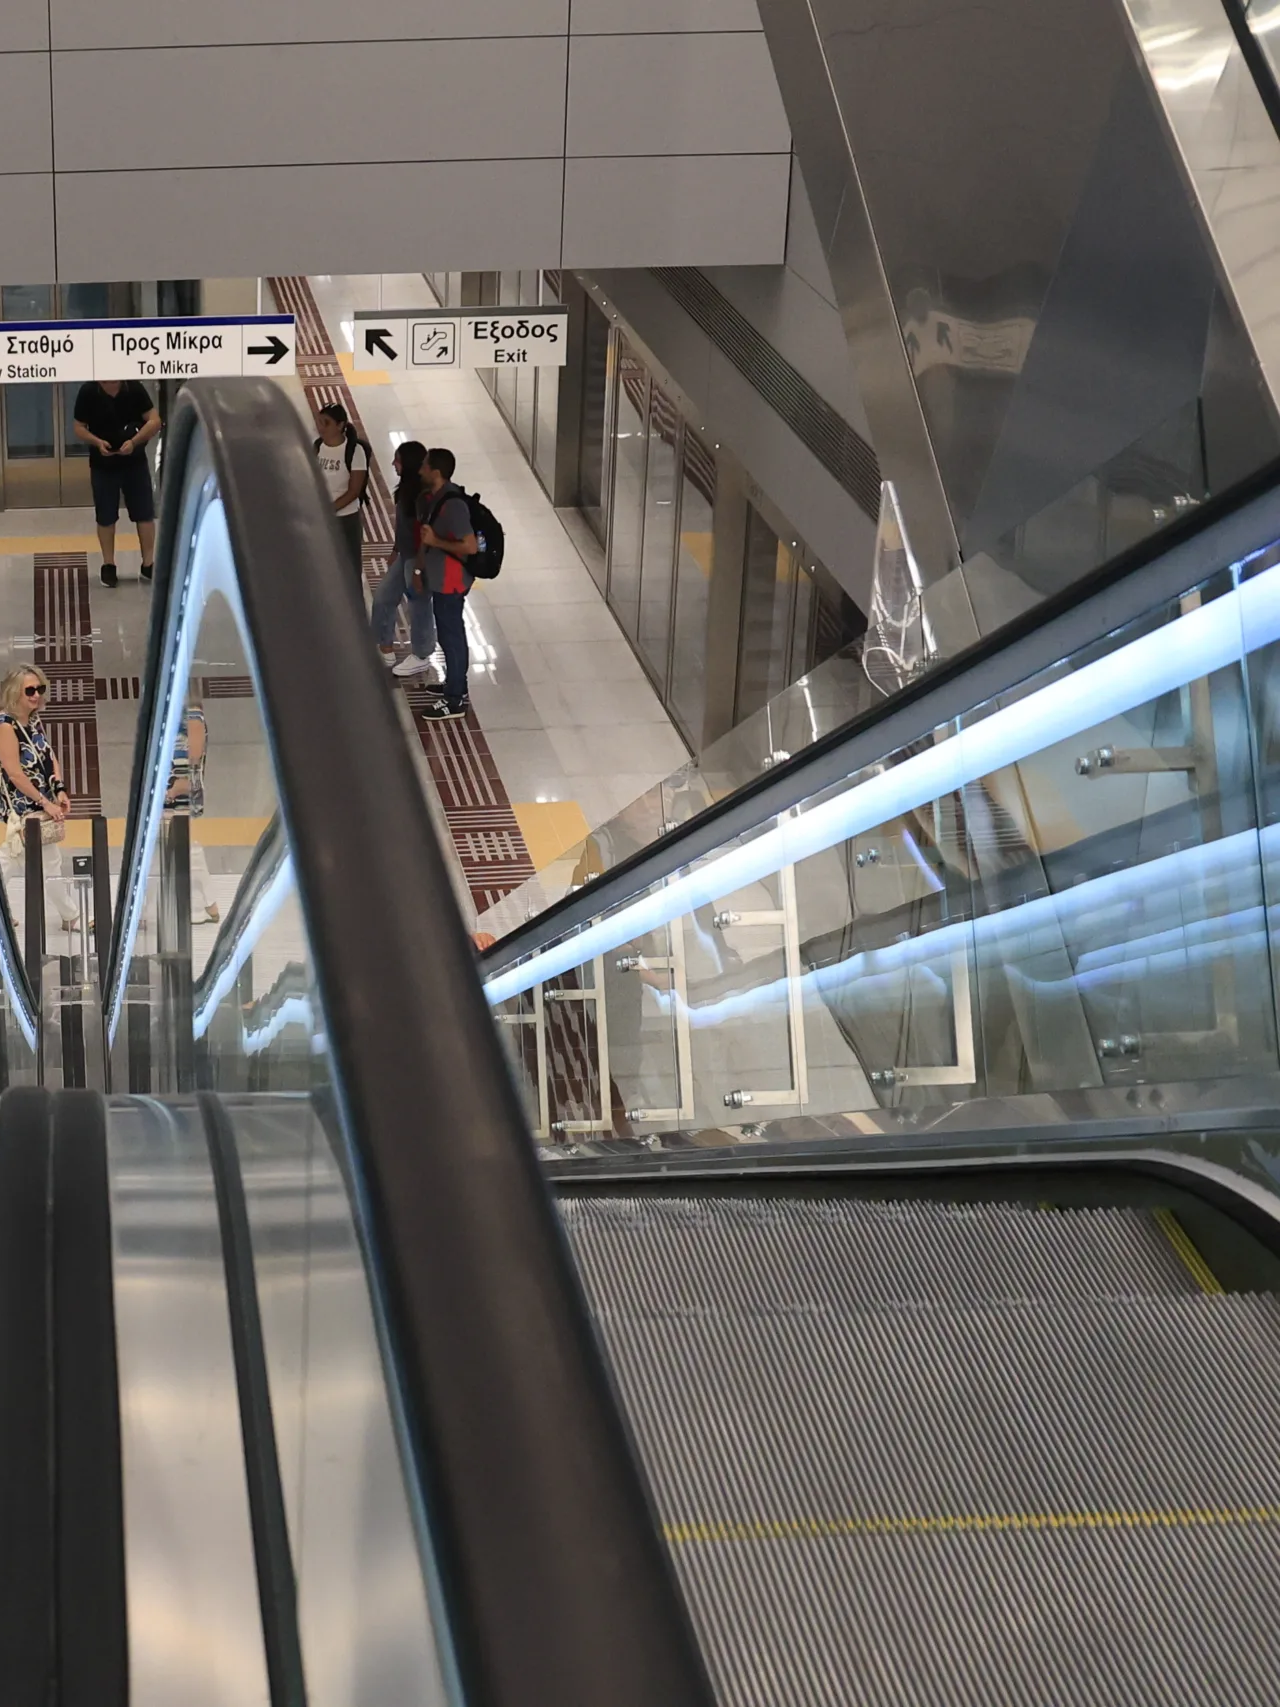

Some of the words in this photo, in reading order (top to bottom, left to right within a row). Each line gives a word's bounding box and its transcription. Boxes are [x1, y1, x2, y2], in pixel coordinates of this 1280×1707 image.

[468, 320, 558, 344] Έξοδος
[7, 335, 74, 358] Σταθμό
[112, 333, 160, 356] Προς
[166, 331, 222, 354] Μίκρα
[494, 349, 527, 363] Exit
[7, 364, 57, 379] Station
[137, 361, 155, 375] To
[160, 360, 198, 374] Mikra
